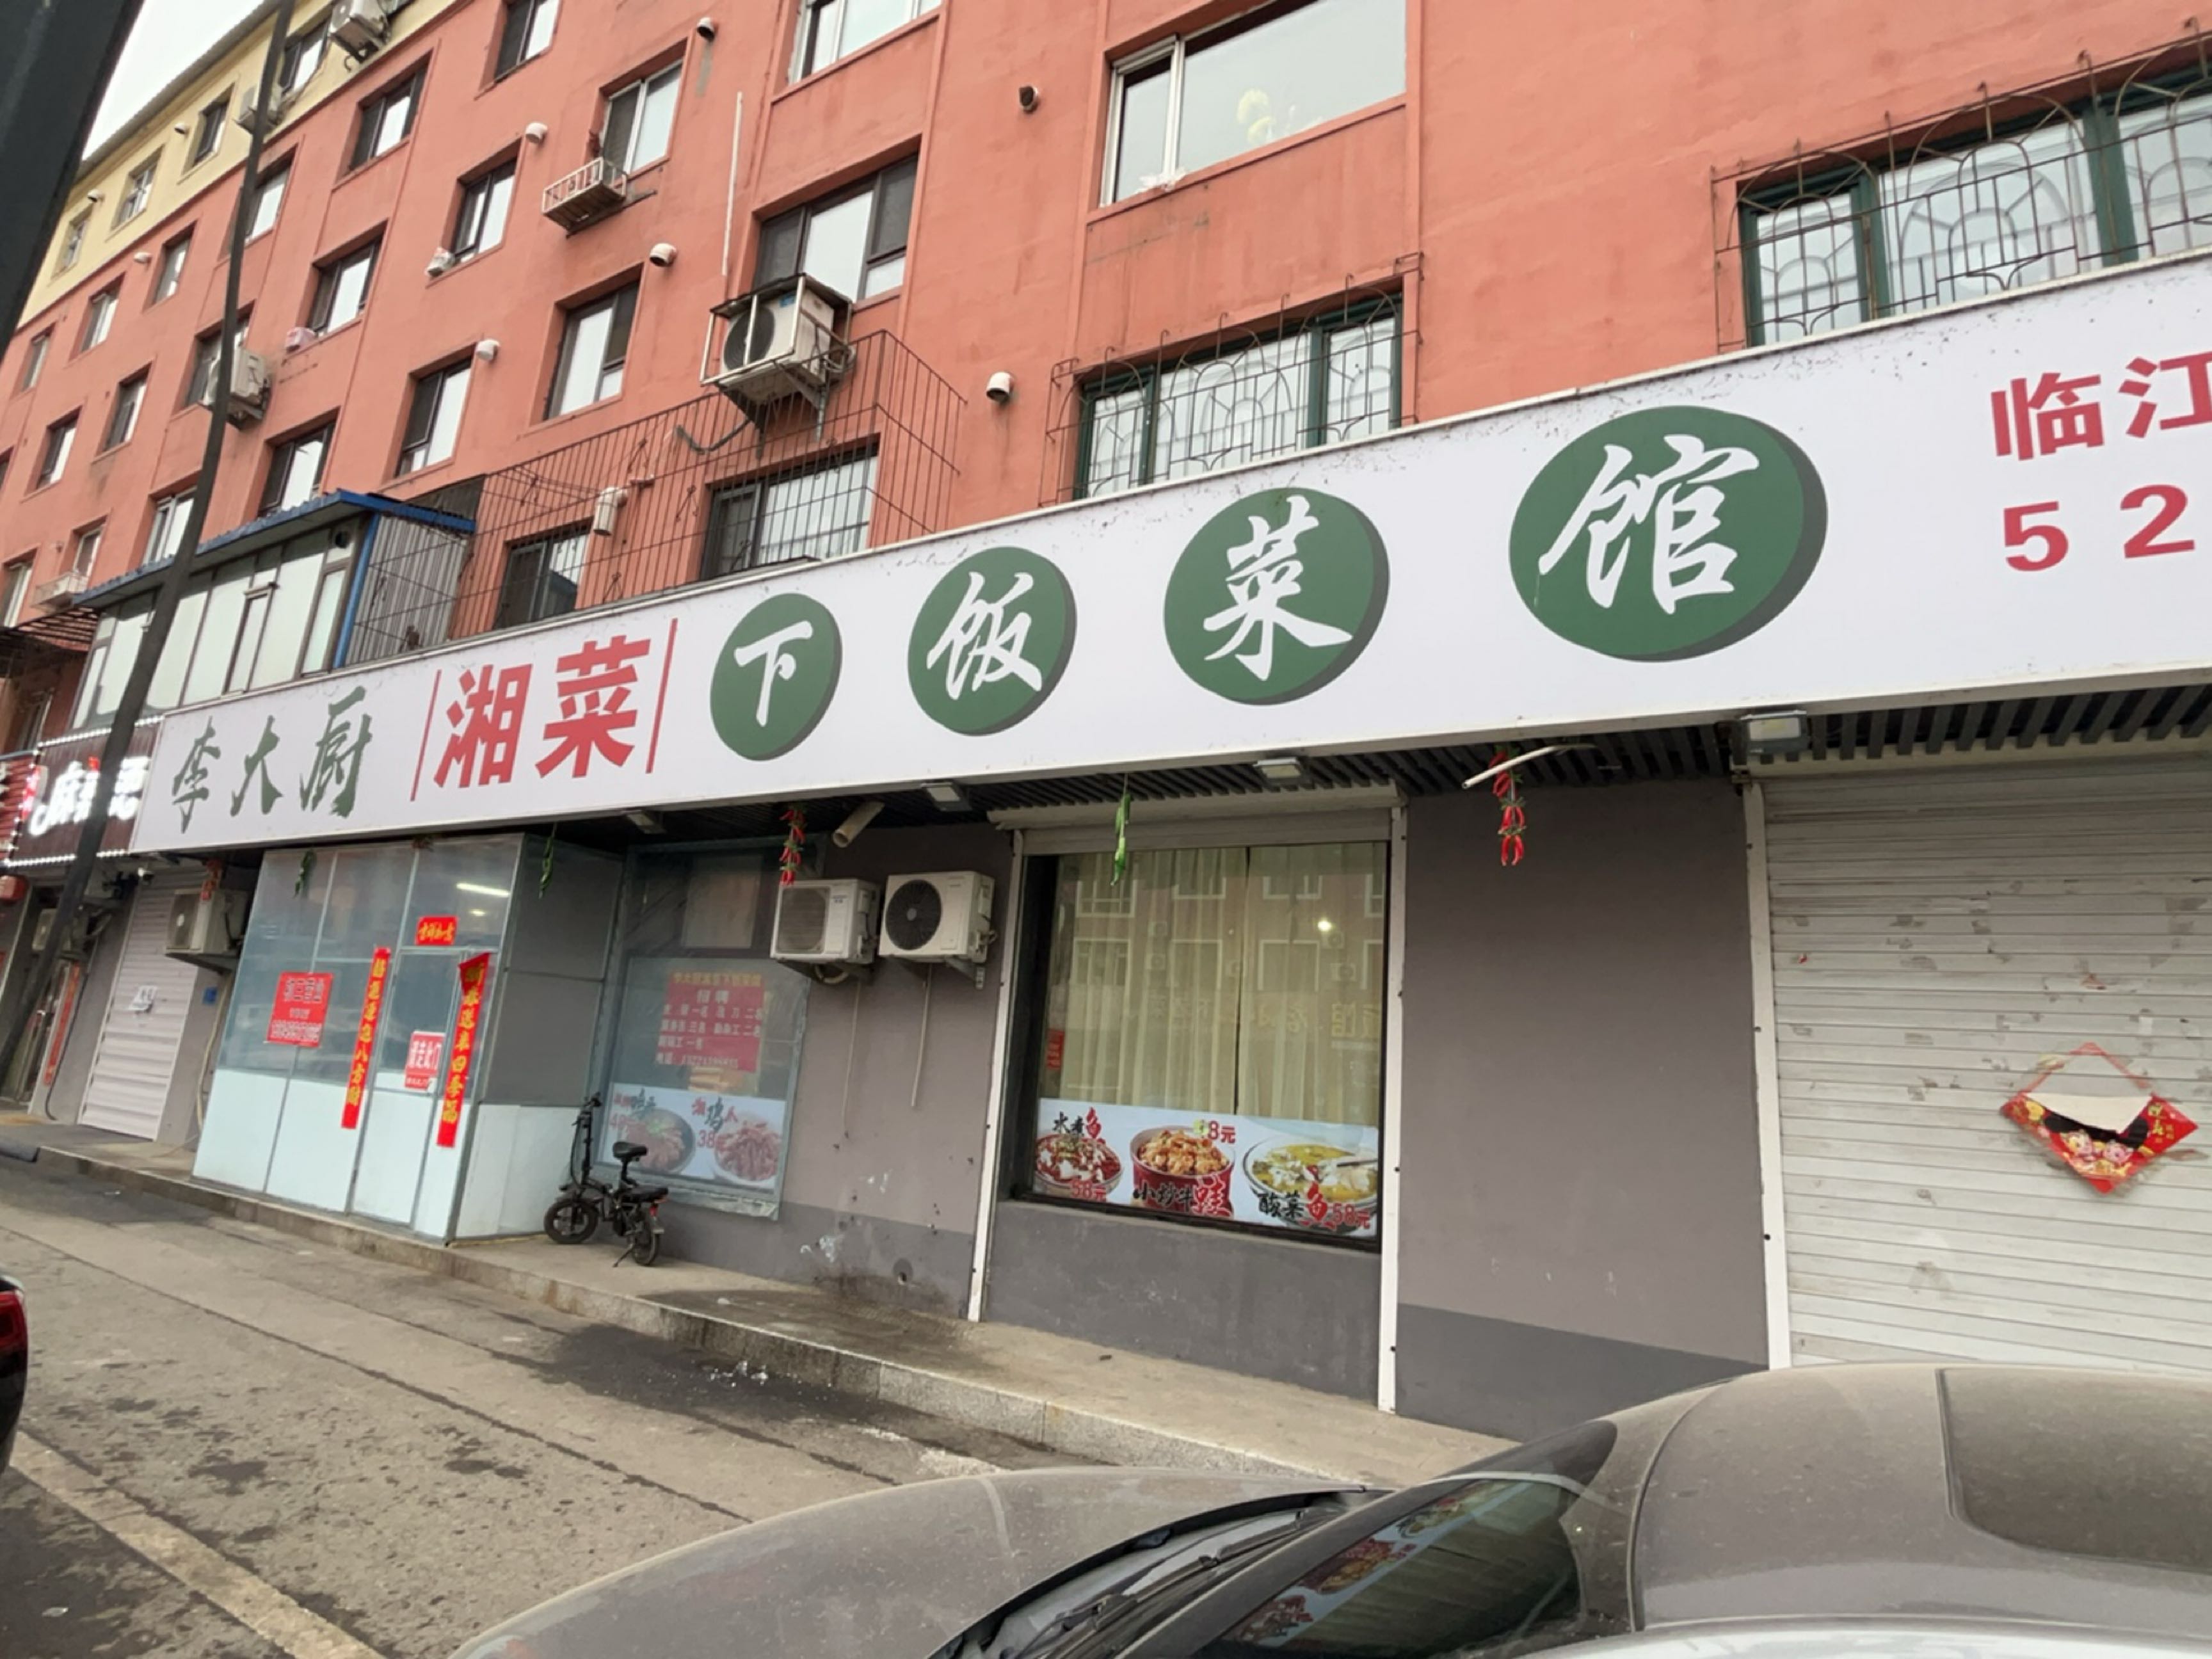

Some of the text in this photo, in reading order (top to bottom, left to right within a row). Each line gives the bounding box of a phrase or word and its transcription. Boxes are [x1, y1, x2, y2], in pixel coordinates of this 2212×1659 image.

[172, 433, 1759, 833] 李大厨 湘菜 下饭菜馆
[1193, 1119, 1237, 1144] 8元
